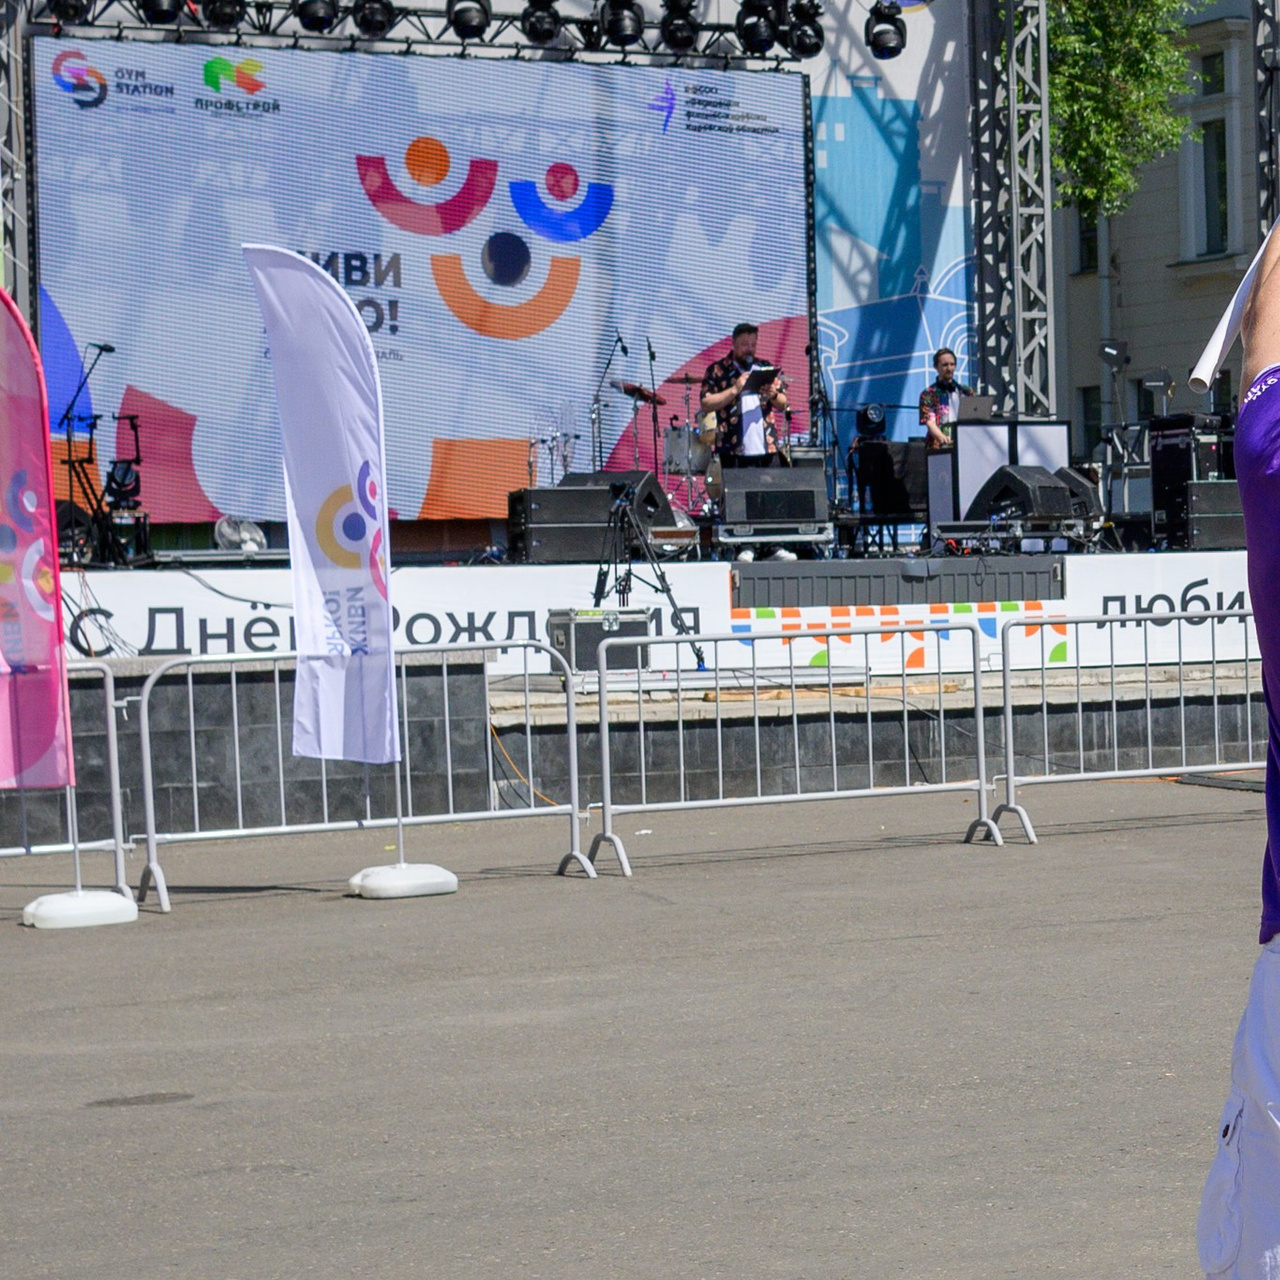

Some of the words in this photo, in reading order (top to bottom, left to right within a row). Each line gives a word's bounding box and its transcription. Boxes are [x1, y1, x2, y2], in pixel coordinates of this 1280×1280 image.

[115, 82, 175, 97] STATION
[296, 250, 402, 288] ИВИ
[69, 608, 115, 657] С
[138, 601, 296, 655] Днё
